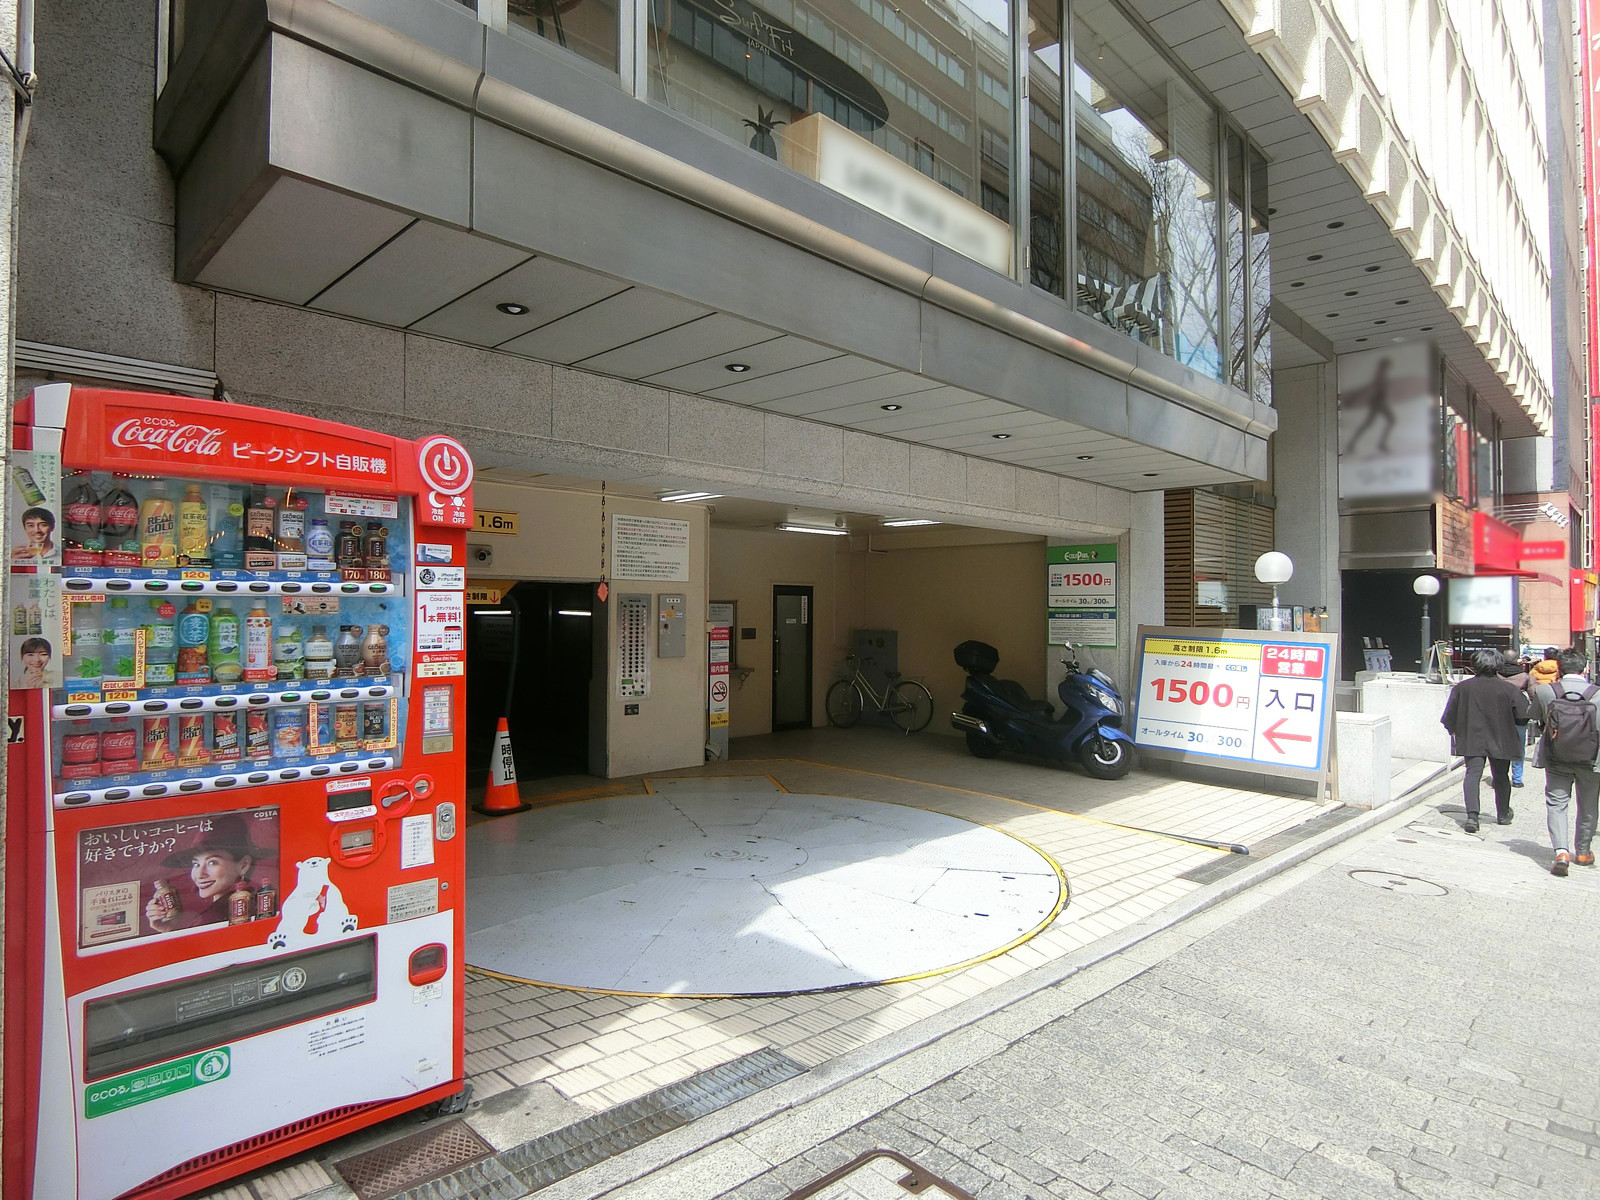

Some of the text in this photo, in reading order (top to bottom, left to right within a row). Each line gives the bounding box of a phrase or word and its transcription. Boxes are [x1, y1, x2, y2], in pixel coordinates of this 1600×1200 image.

[714, 0, 795, 57] Surf Fit
[746, 38, 770, 56] JAPAN
[112, 419, 226, 456] Coca-Cola
[233, 443, 387, 474] ピークシフト自販機
[147, 512, 174, 526] REAL
[479, 514, 513, 530] 1.6m
[147, 521, 174, 534] GOLD
[1064, 573, 1111, 586] 1500円
[188, 617, 202, 641] 麦茶
[1173, 645, 1227, 655] 高さ制限 1.6m
[1267, 649, 1318, 662] 24時間
[1154, 658, 1221, 671] 入庫から24時間最
[1278, 662, 1305, 675] 営業
[1151, 678, 1250, 710] 1500円
[1265, 689, 1315, 712] 入口
[1141, 727, 1184, 739] オールタイム
[500, 734, 514, 781] 一時停止
[254, 810, 278, 818] COSTA
[84, 819, 213, 846] おいしいコーヒーは
[85, 838, 176, 864] 好きですか?
[164, 894, 174, 909] COSTA
